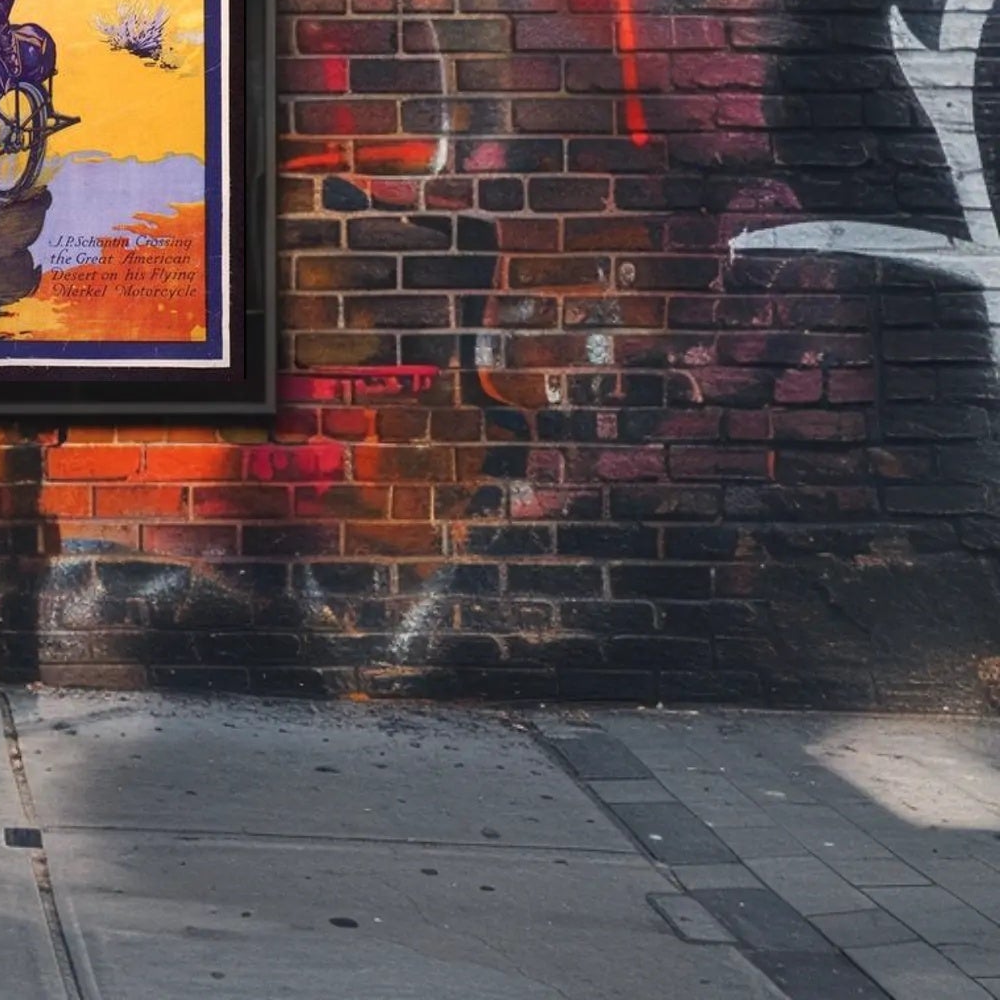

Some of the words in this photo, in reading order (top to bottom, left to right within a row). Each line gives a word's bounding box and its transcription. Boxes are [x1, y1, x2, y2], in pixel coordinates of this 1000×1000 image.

[135, 235, 192, 249] Crossing
[50, 250, 72, 265] the
[76, 253, 114, 265] Great
[122, 250, 190, 265] American
[51, 269, 97, 281] Desert
[101, 272, 118, 281] on
[124, 269, 145, 281] his
[151, 268, 197, 283] Flying
[52, 284, 107, 297] Merkel
[115, 284, 197, 300] Motorcycle
